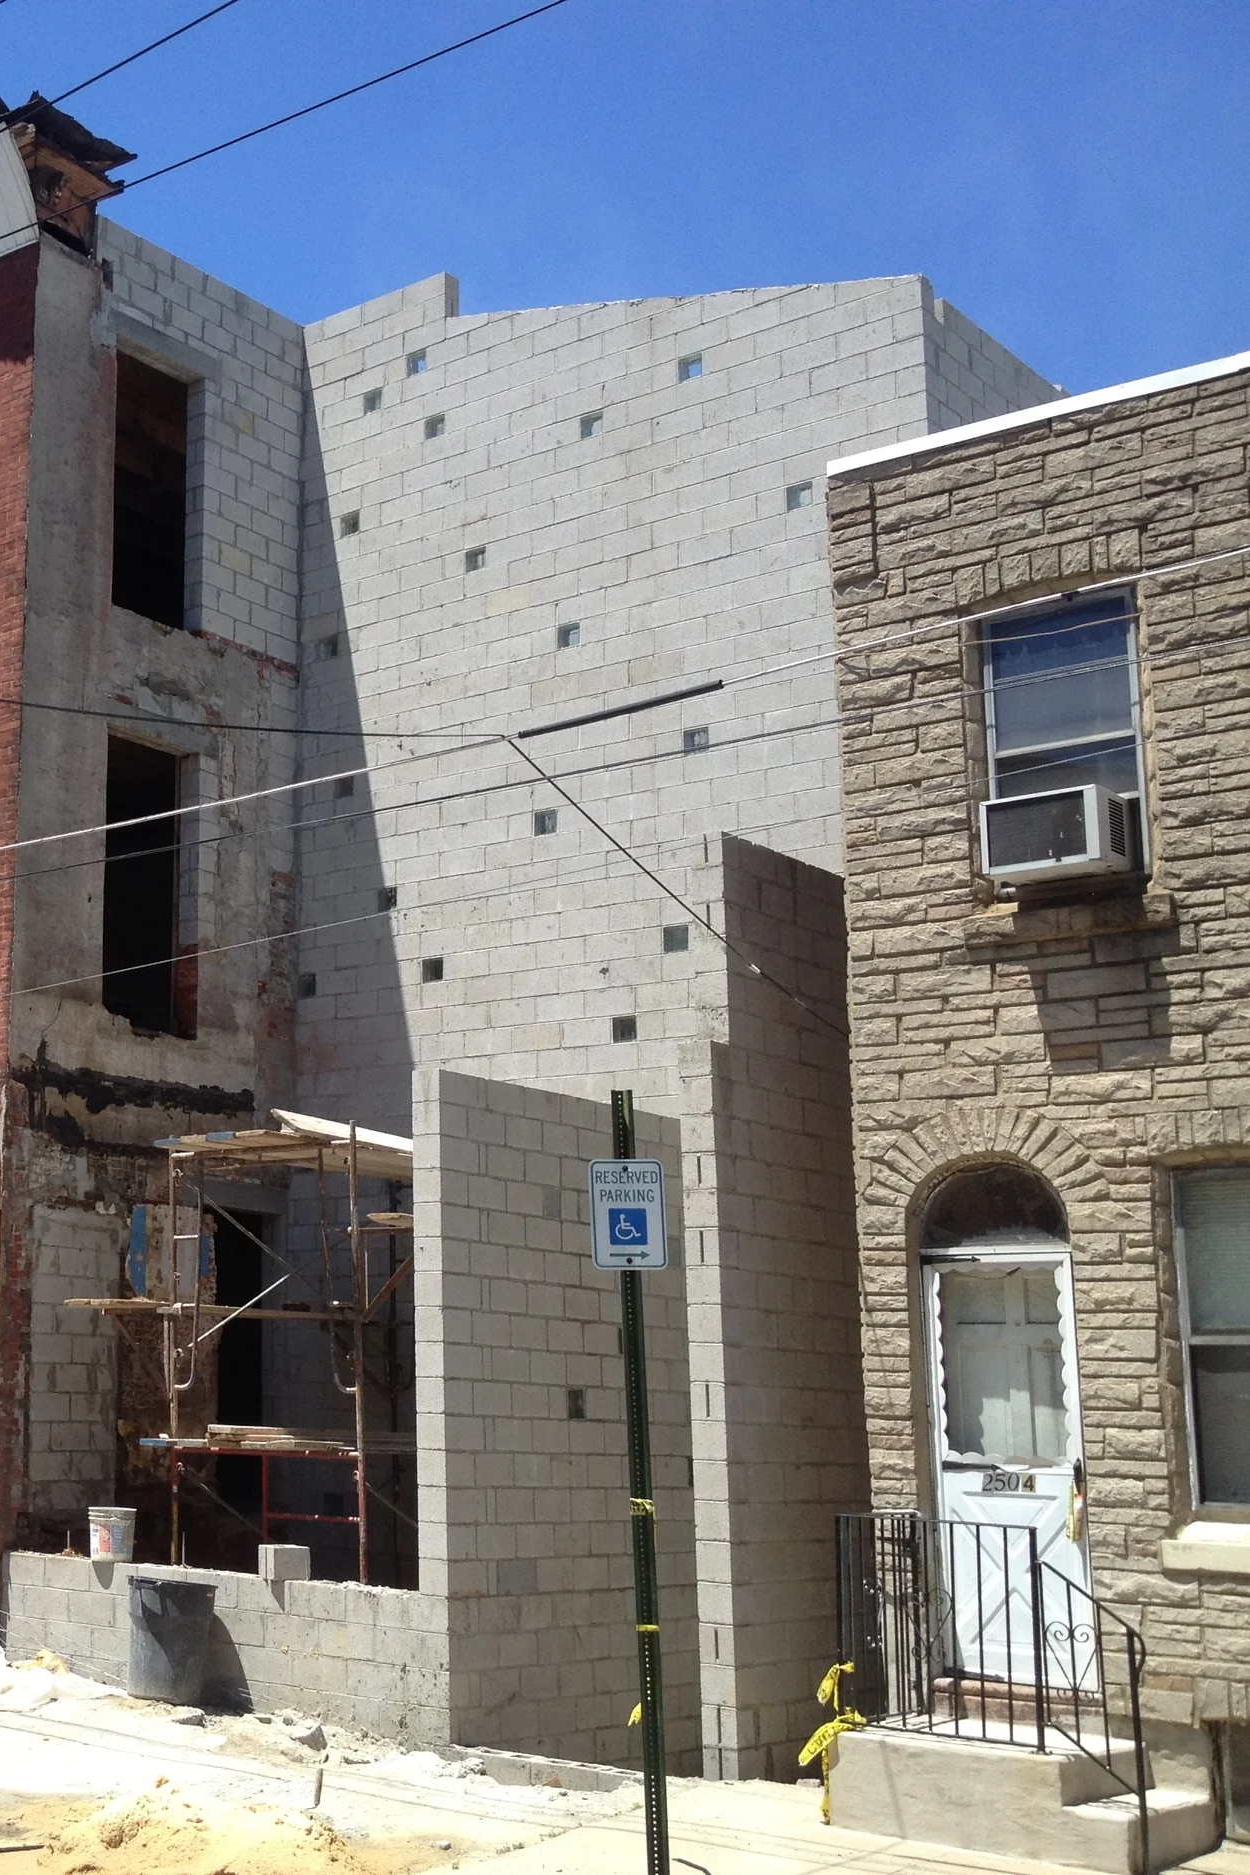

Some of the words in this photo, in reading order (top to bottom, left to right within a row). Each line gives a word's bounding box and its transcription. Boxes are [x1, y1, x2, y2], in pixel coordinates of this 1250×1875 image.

[595, 1171, 658, 1184] RESERVED
[600, 1189, 655, 1203] PARKING
[982, 1473, 1034, 1491] 2504
